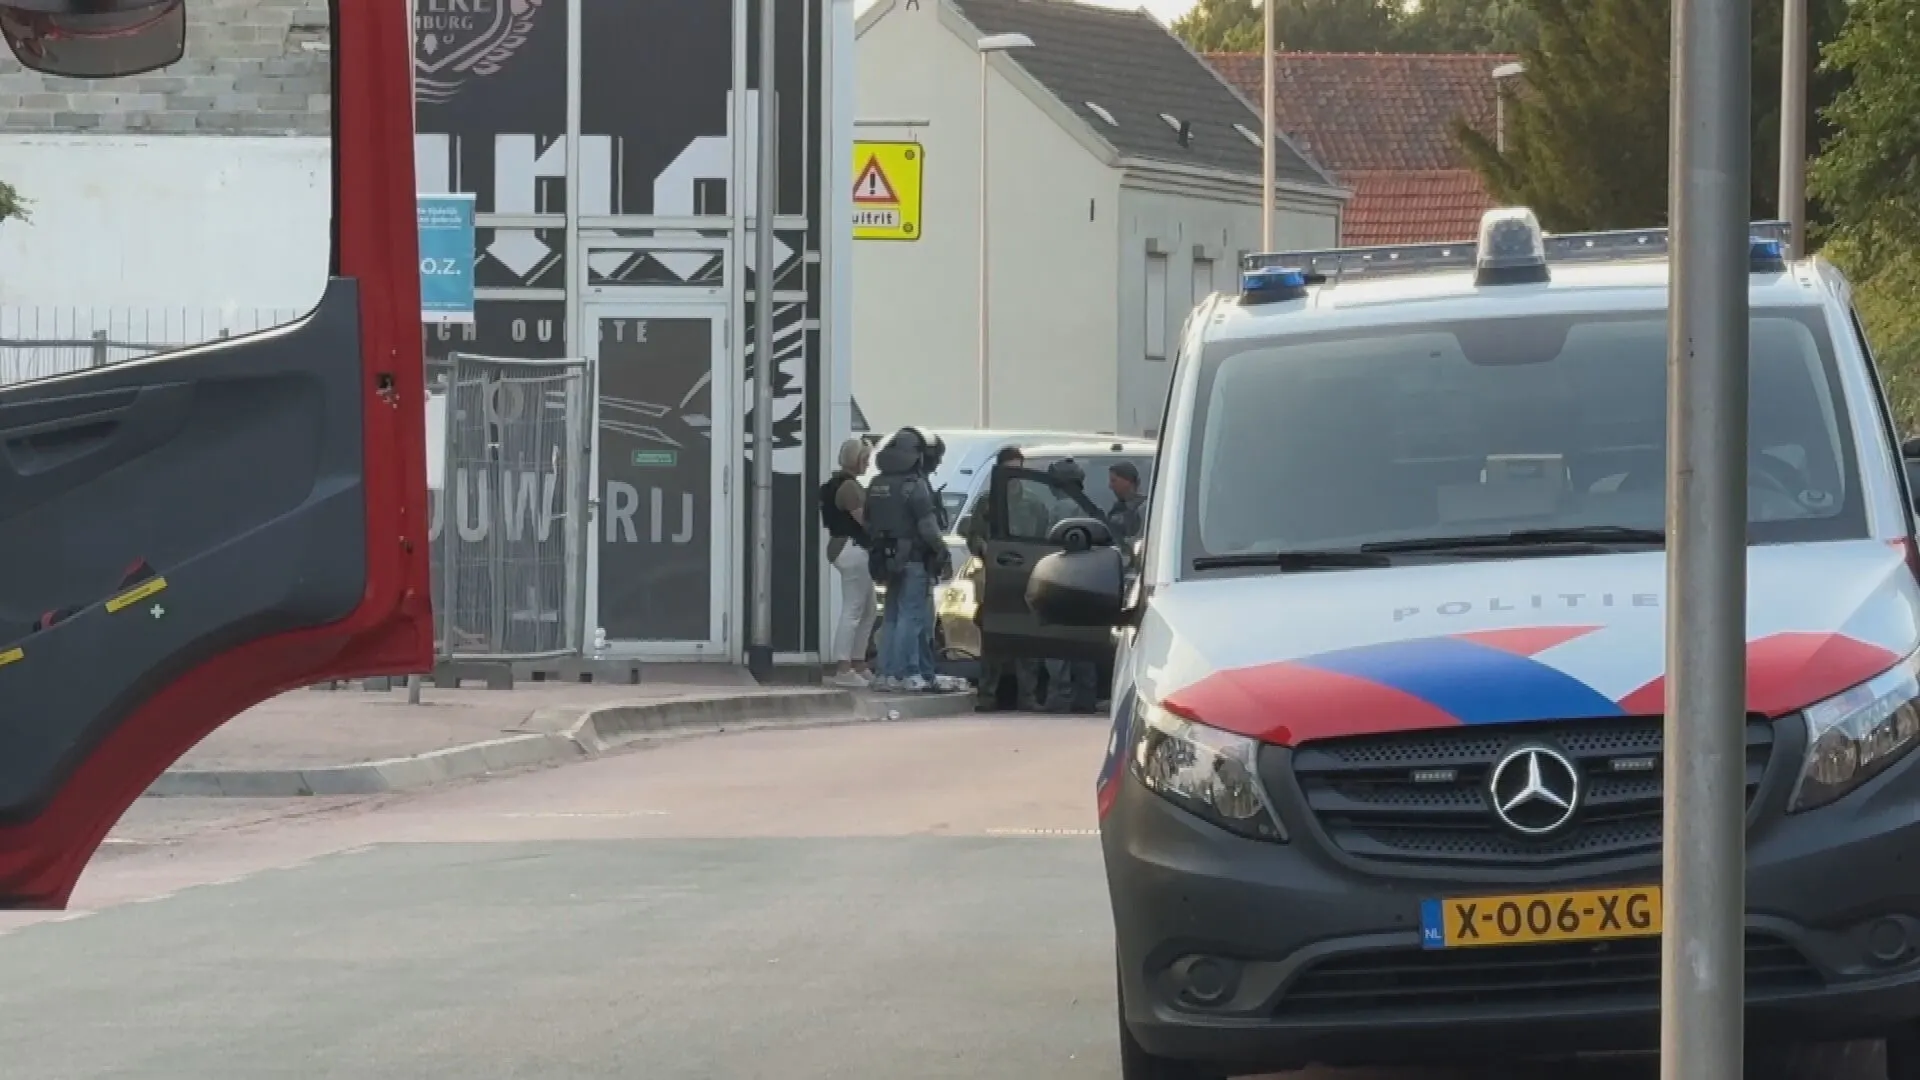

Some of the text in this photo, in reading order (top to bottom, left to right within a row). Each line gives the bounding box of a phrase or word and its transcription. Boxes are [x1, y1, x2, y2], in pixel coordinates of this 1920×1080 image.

[1392, 593, 1660, 622] POLITIE
[1455, 893, 1651, 939] X-006-XG
[1424, 927, 1442, 940] NL
